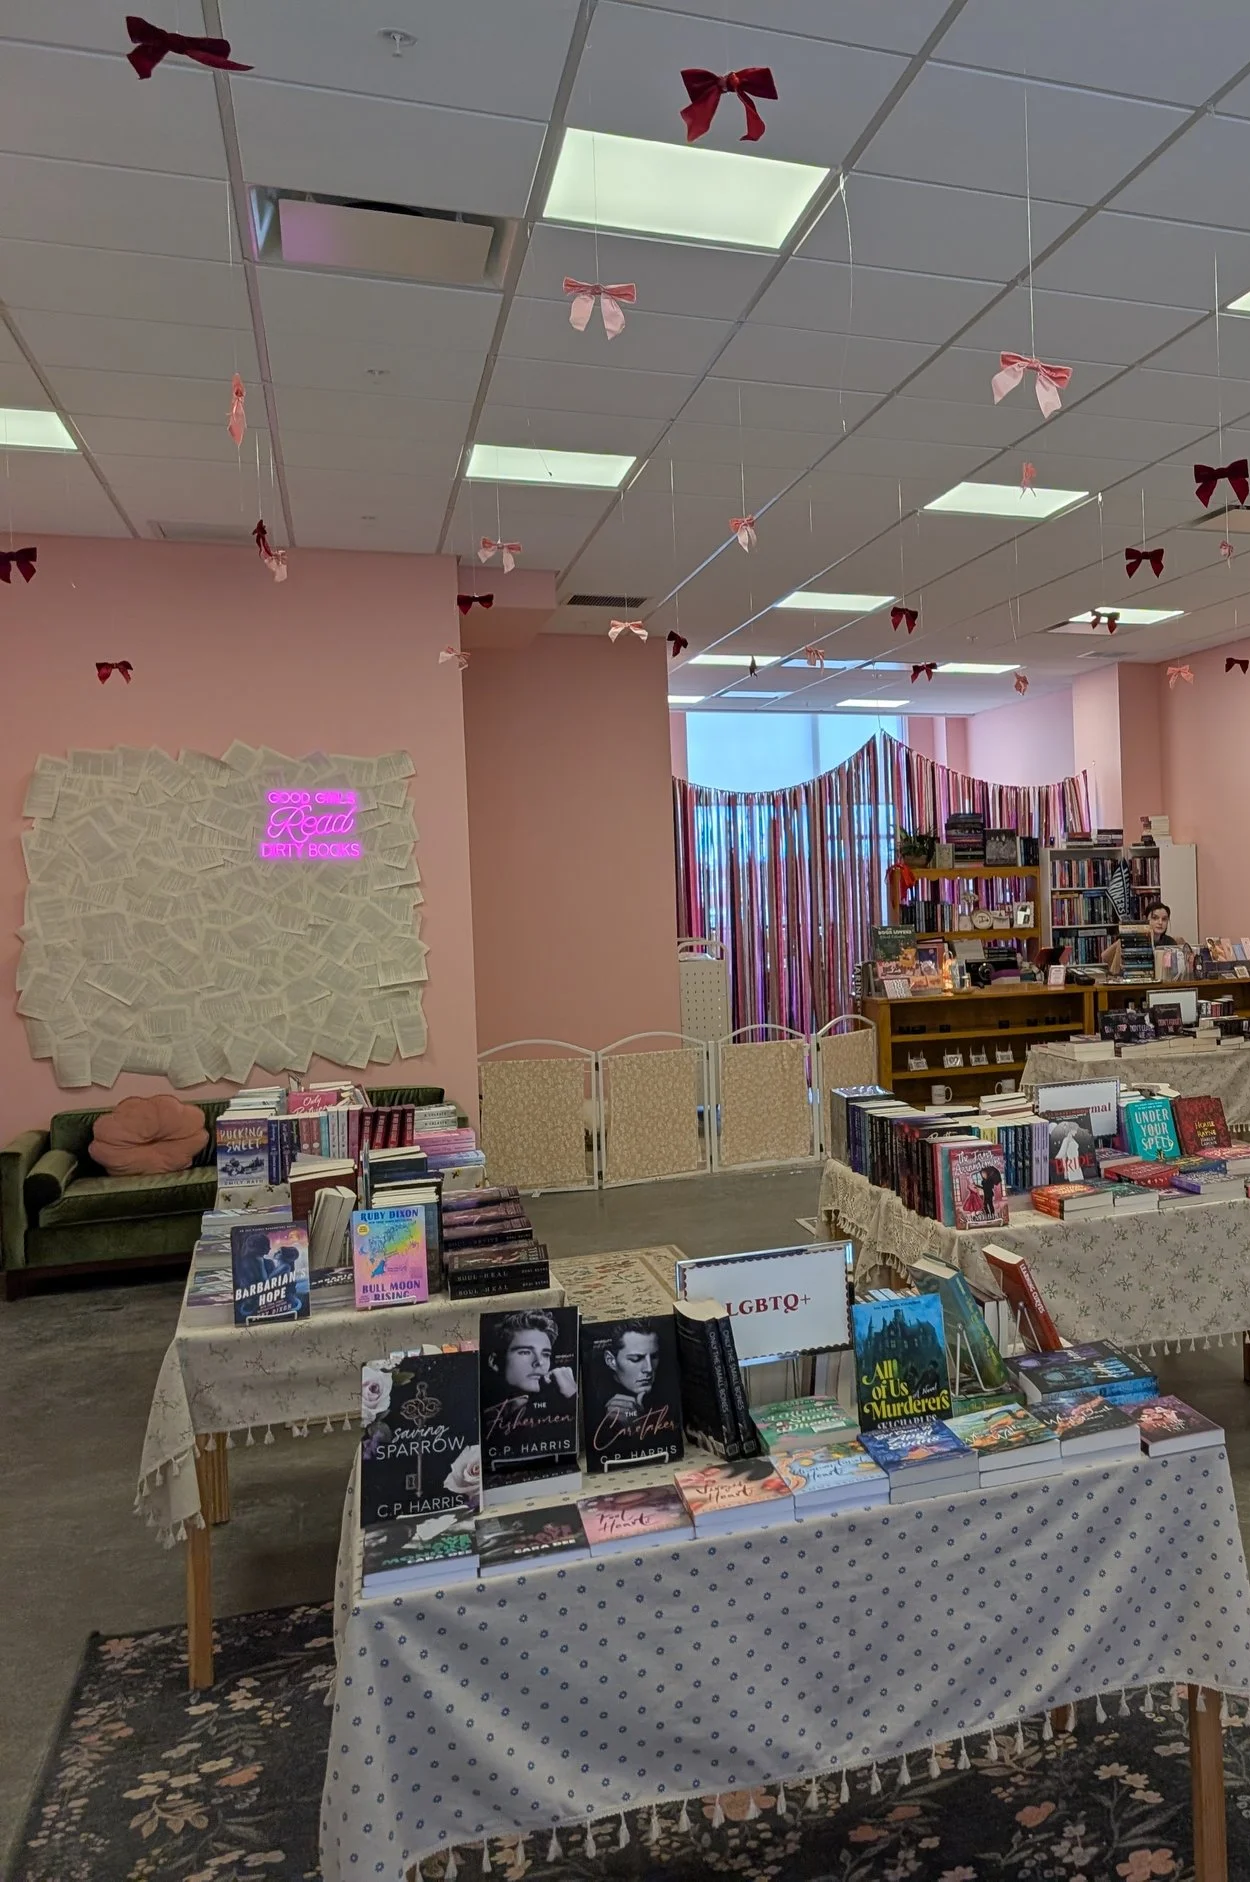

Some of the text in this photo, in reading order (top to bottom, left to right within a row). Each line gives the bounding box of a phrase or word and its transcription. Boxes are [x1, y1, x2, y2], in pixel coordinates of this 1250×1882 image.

[268, 792, 310, 804] GOOD
[267, 804, 357, 843] Read
[261, 843, 360, 858] DIRTY BOOKS
[303, 1095, 321, 1107] Only
[1091, 1102, 1111, 1113] mal
[1135, 1108, 1169, 1124] UNDER
[220, 1127, 264, 1140] PUCKING
[1141, 1122, 1169, 1137] YOUR
[227, 1140, 260, 1152] SWEET
[1141, 1136, 1172, 1151] SPELL
[1055, 1152, 1095, 1175] BRIDE
[360, 1211, 386, 1222] RUBY
[389, 1208, 418, 1219] DIXON
[362, 1280, 421, 1294] BULL MOON
[374, 1291, 410, 1301] RISING
[1020, 1263, 1045, 1314] LEARNING CURVES
[259, 1287, 287, 1307] HOPE
[726, 1293, 811, 1316] LGBTQ+
[708, 1331, 717, 1348] ONLY
[723, 1329, 731, 1347] ONLY
[714, 1363, 724, 1388] SMALL
[730, 1362, 739, 1388] SMALL
[862, 1359, 898, 1385] All
[872, 1378, 908, 1400] of Us
[922, 1382, 937, 1395] Novel
[718, 1388, 727, 1413] BONES
[734, 1388, 744, 1411] BONES
[864, 1389, 950, 1420] Murderers
[484, 1395, 573, 1440] Fishermen
[392, 1425, 449, 1443] saving
[593, 1405, 675, 1450] Caretaker
[376, 1436, 464, 1460] SPARROW
[522, 1440, 570, 1453] HARRIS
[631, 1446, 677, 1460] HARRIS
[377, 1495, 464, 1517] C.P. HARRIS
